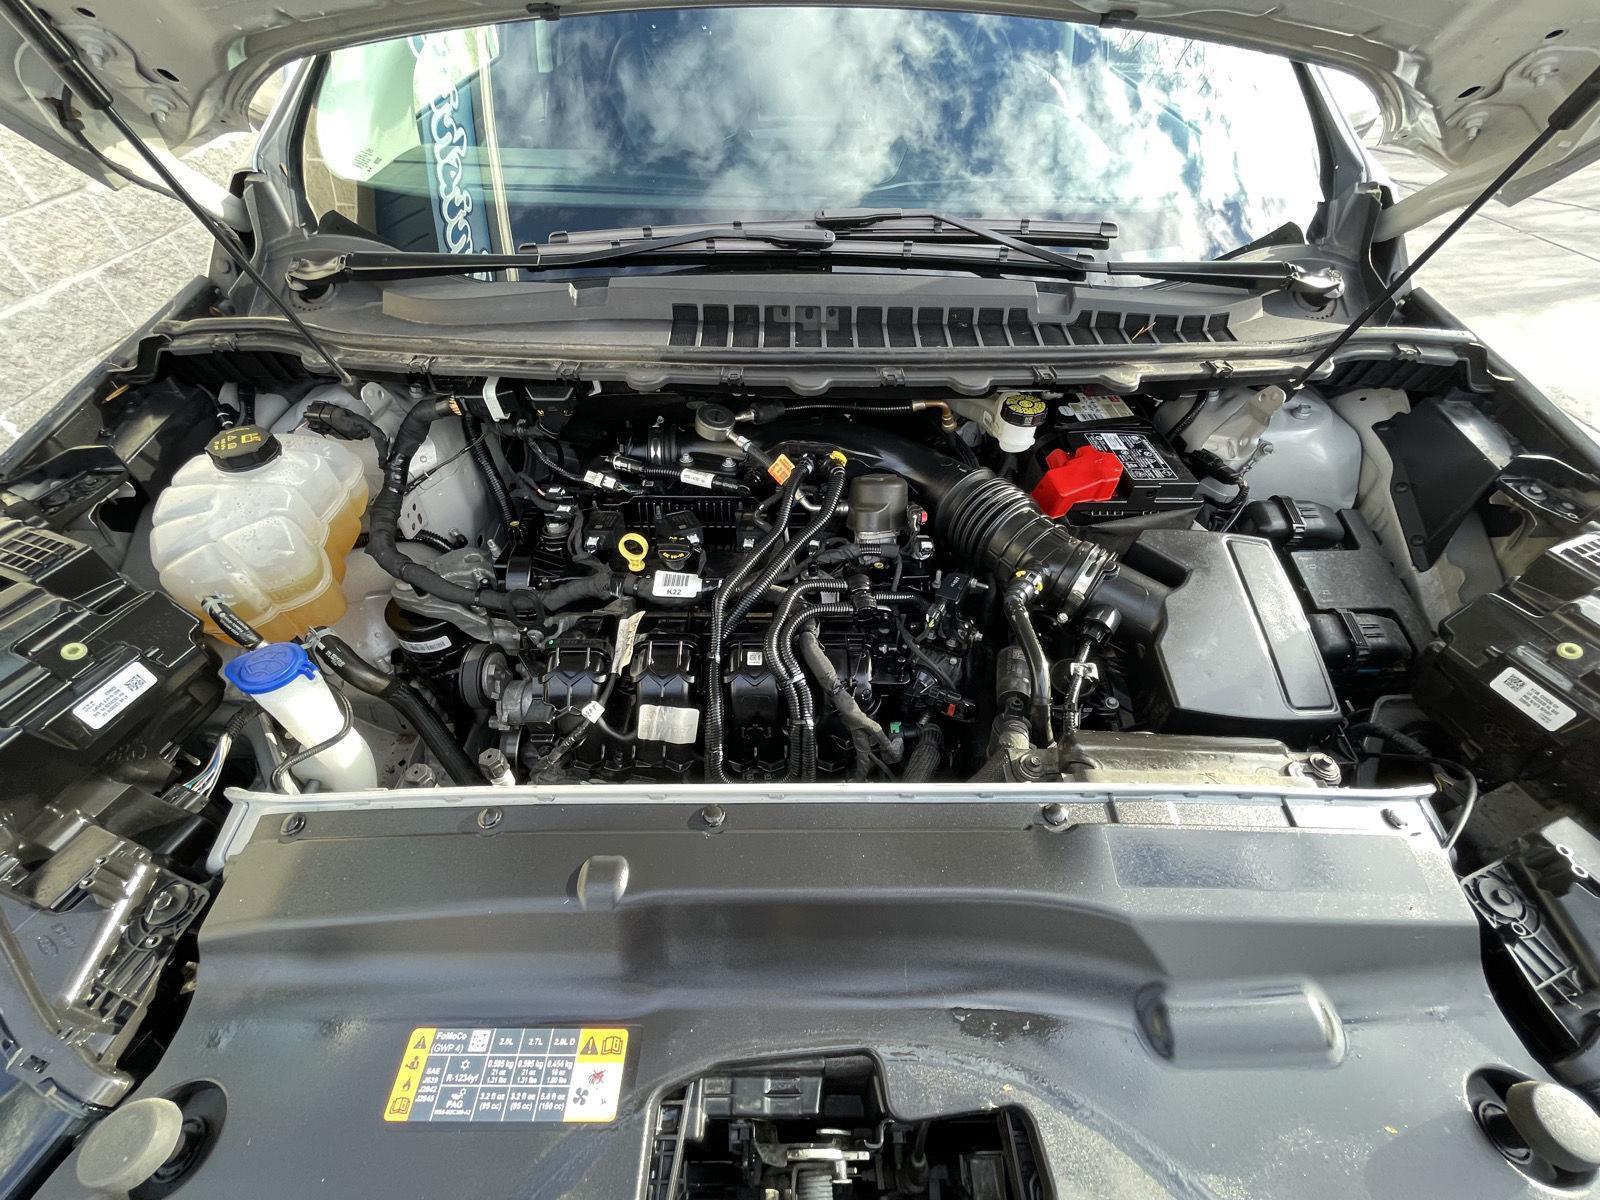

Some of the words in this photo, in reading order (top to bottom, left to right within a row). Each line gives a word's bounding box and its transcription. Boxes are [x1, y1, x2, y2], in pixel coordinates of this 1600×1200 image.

[436, 1031, 467, 1040] FoMoCo
[430, 1043, 455, 1054] (GWP
[446, 1073, 479, 1084] R-1234yf
[446, 1100, 464, 1109] PAG
